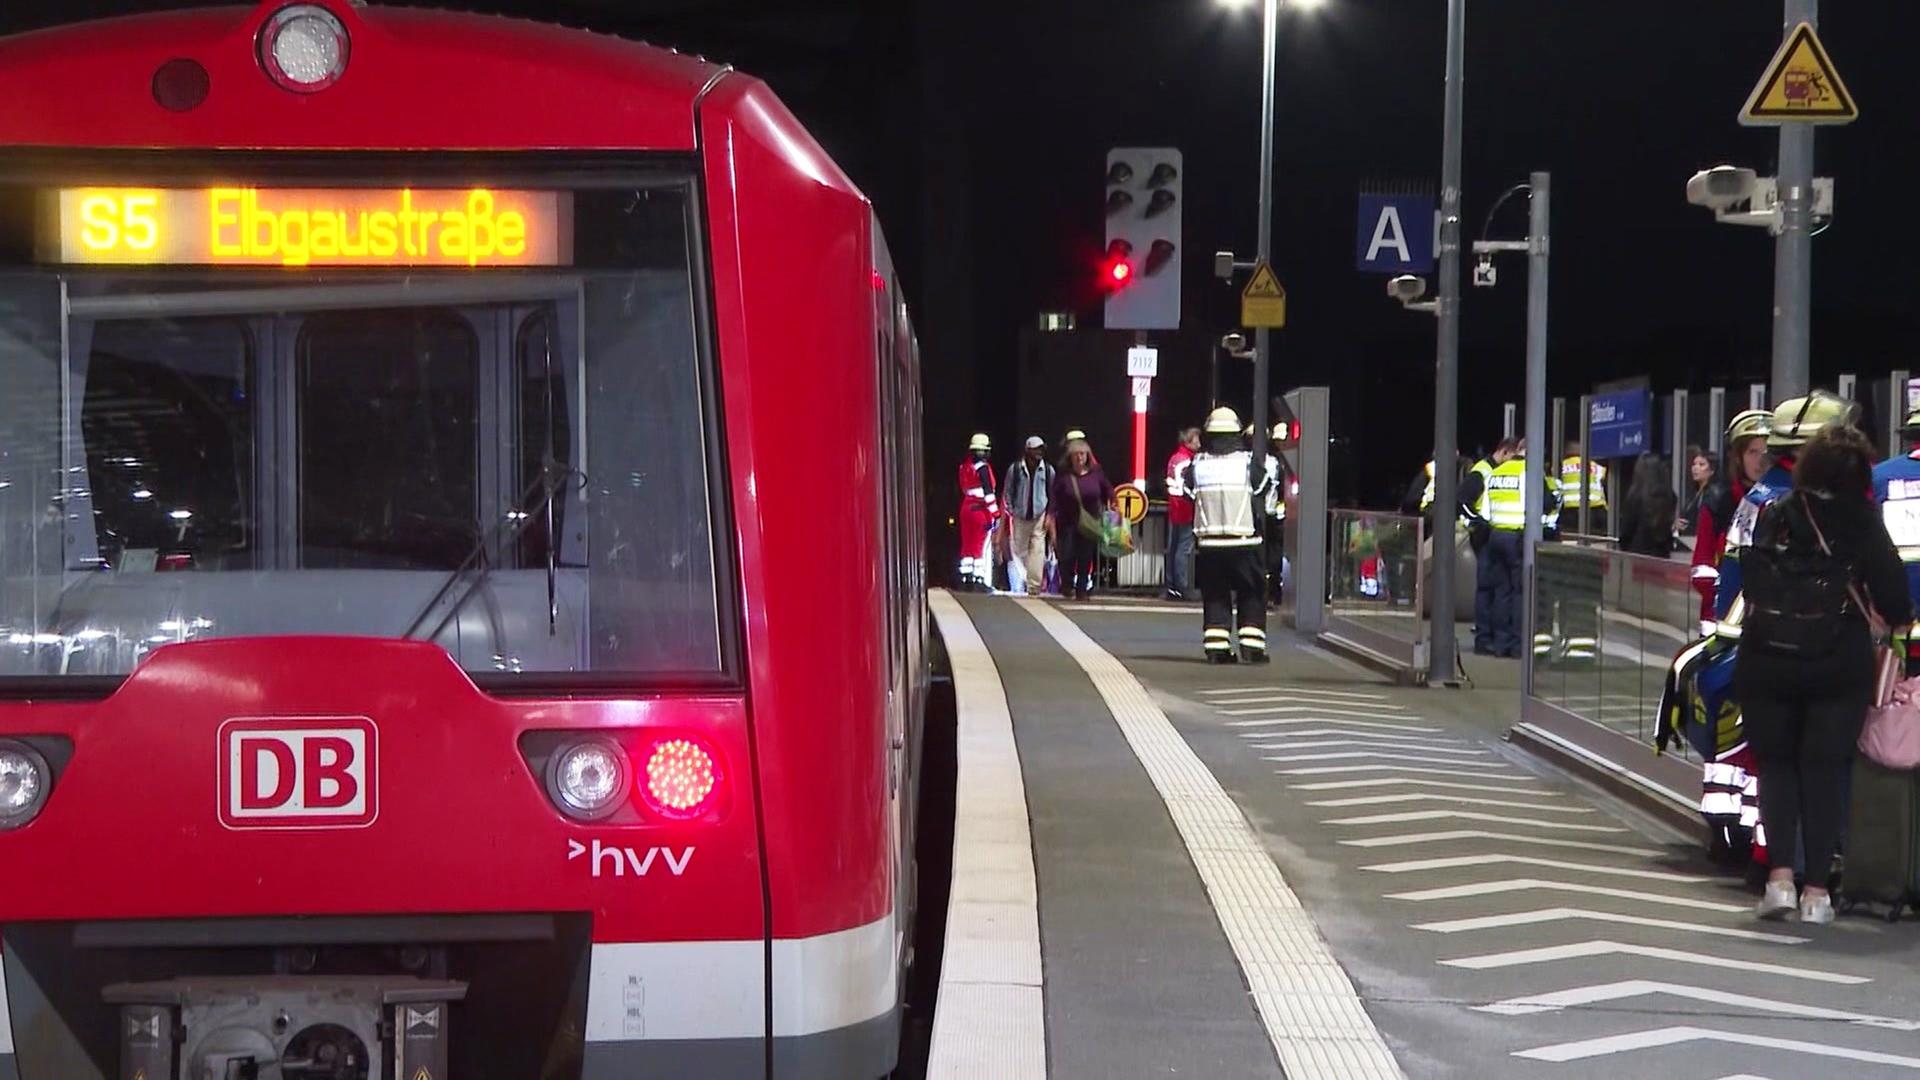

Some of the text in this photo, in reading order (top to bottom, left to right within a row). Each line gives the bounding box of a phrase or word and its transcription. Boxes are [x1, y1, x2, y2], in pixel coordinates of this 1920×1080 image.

[80, 188, 527, 266] S5 Elbgaustraße
[1365, 206, 1411, 262] A
[240, 738, 358, 809] DB
